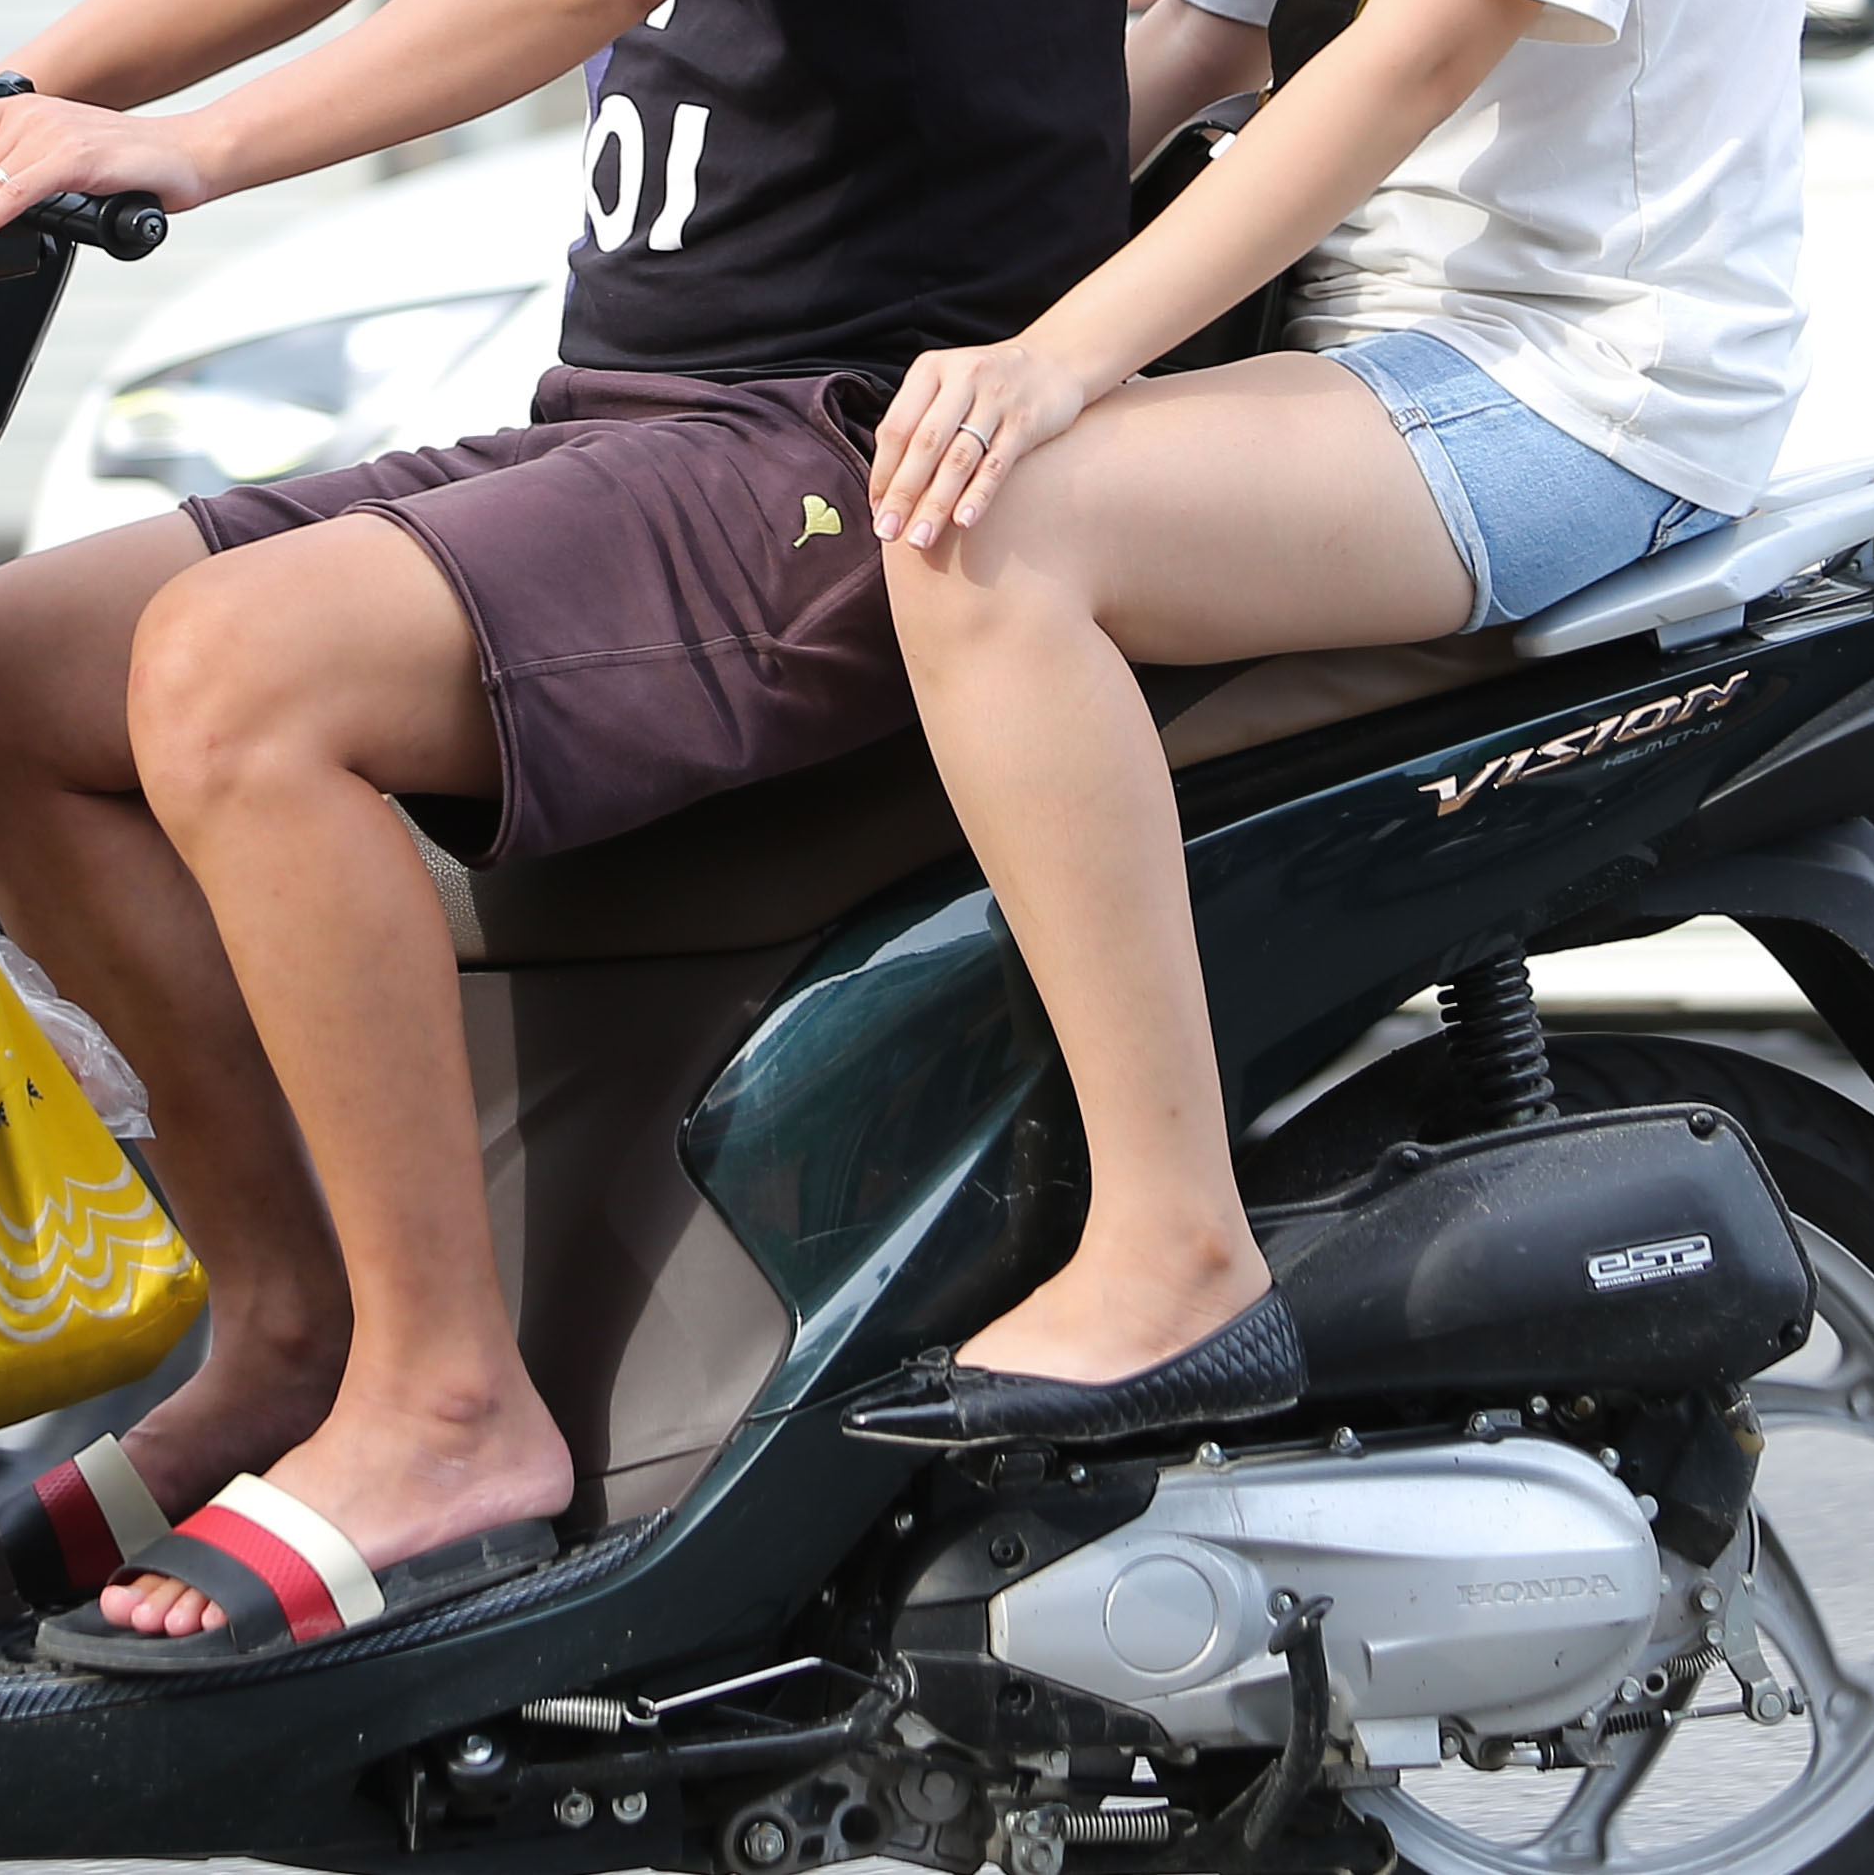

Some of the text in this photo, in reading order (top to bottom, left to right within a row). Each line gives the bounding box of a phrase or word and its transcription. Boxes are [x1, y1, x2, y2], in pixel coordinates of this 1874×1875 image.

[1417, 670, 1749, 817] VISION
[1601, 720, 1723, 771] HELMET-IN
[1456, 1573, 1621, 1607] HONDA
